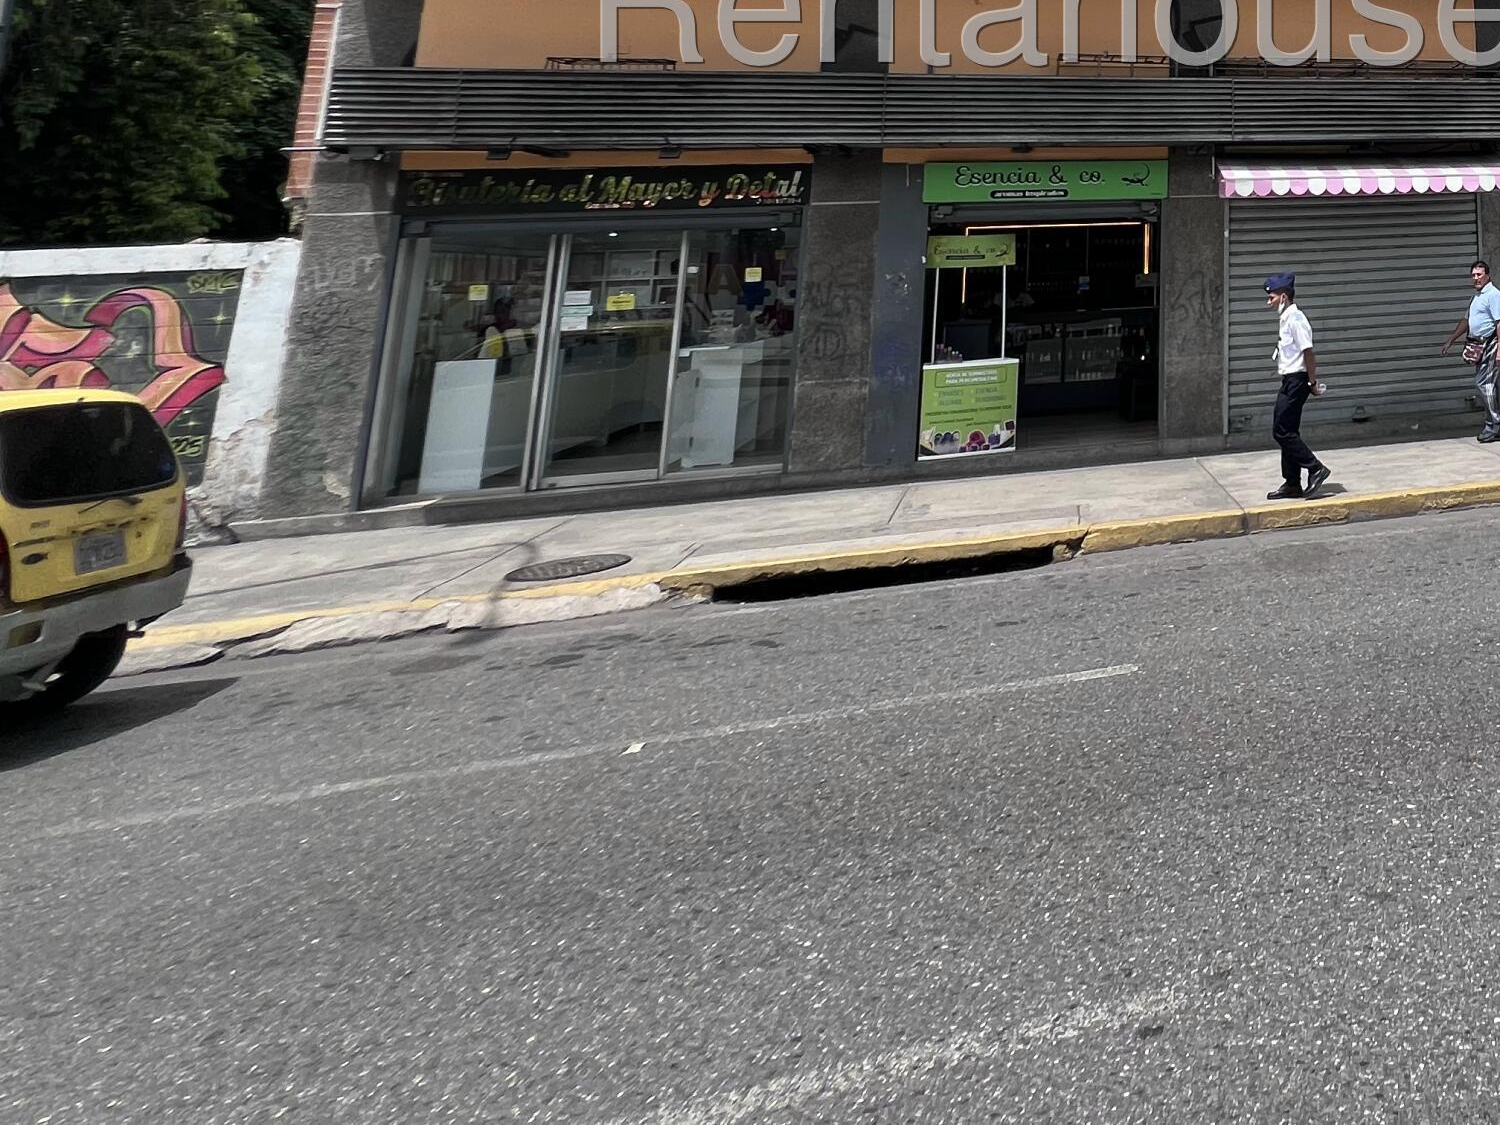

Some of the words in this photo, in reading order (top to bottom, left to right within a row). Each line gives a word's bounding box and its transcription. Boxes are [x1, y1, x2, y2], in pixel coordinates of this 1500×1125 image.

[559, 173, 596, 203] al
[599, 175, 698, 206] Mayor
[698, 181, 721, 207] y
[724, 170, 804, 200] Detal
[954, 165, 1042, 187] Esencia
[1049, 165, 1068, 185] &
[1079, 170, 1107, 184] co.
